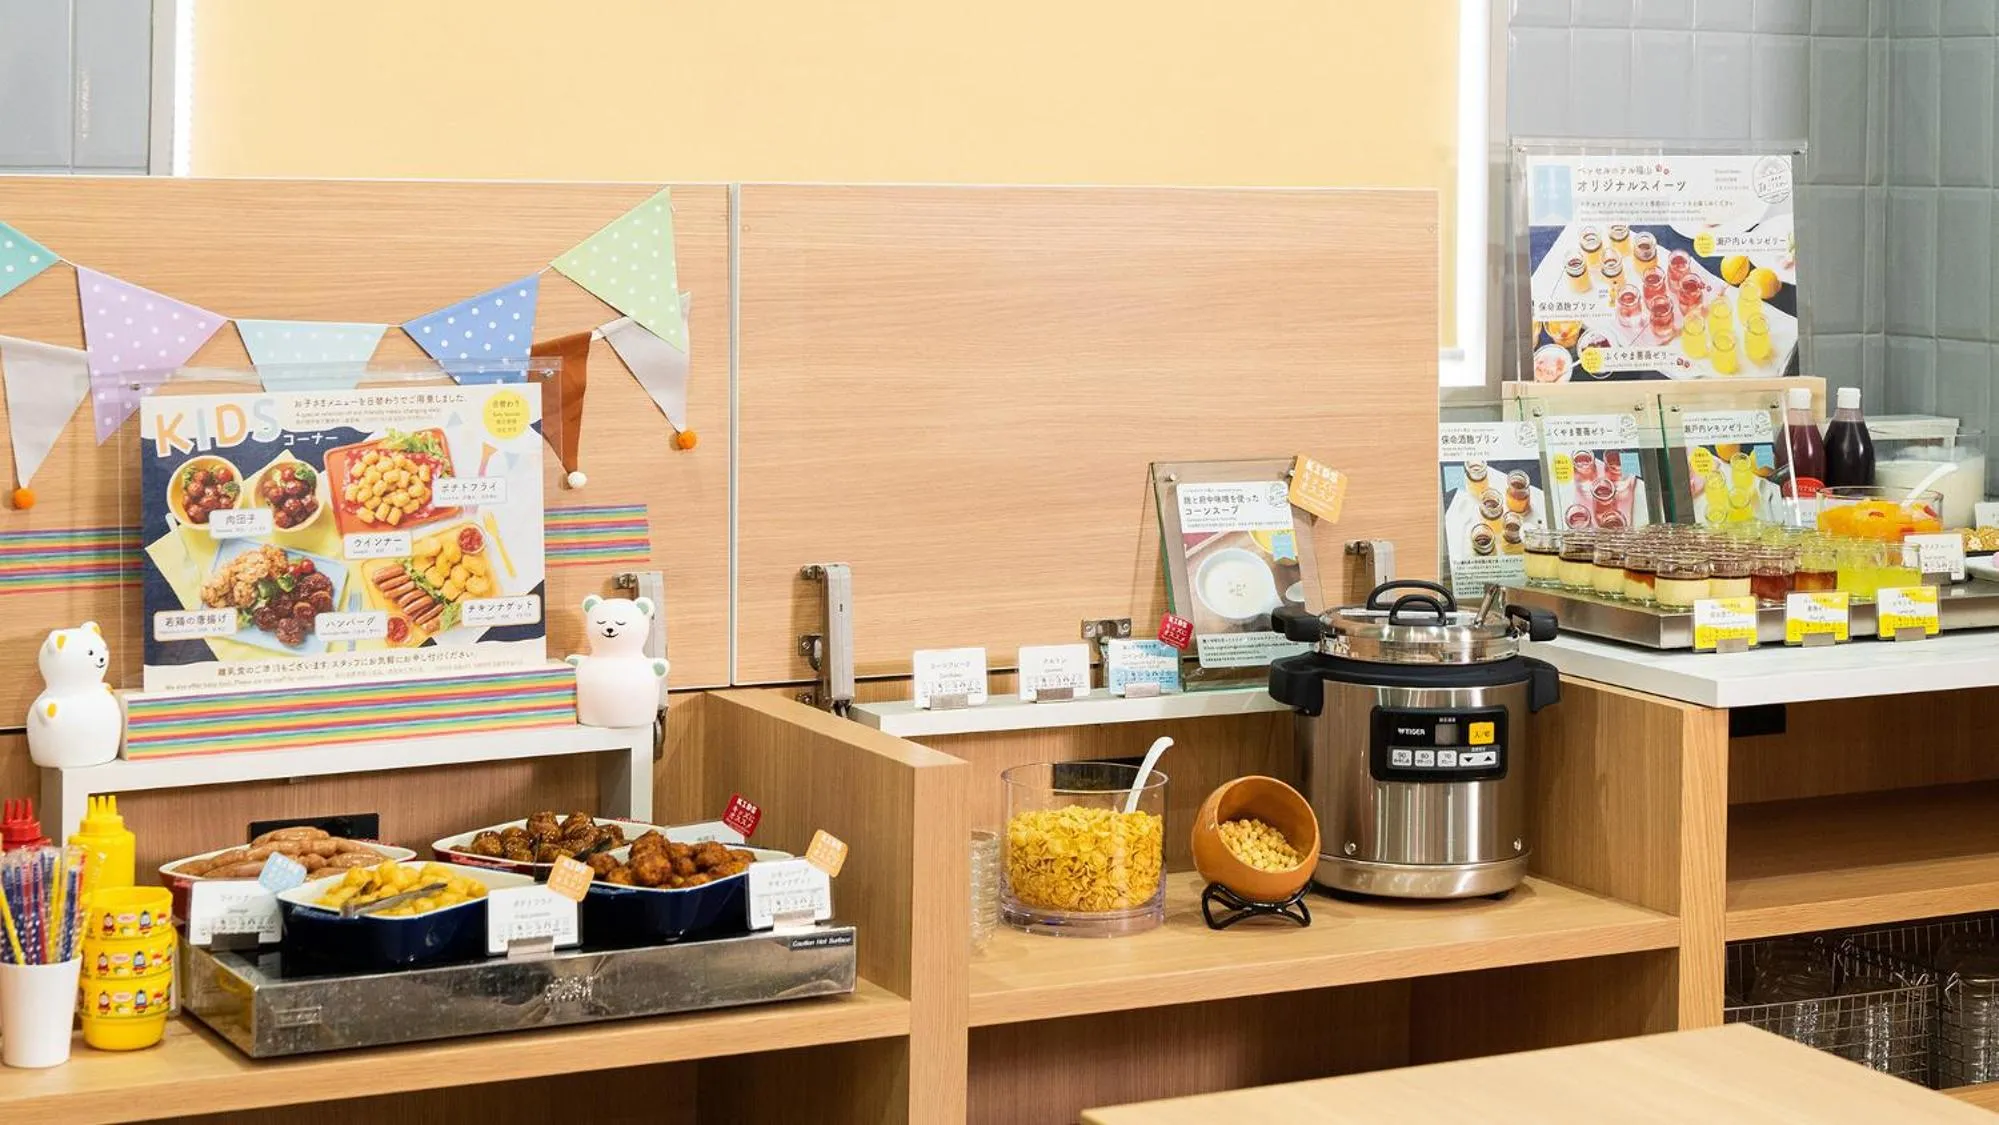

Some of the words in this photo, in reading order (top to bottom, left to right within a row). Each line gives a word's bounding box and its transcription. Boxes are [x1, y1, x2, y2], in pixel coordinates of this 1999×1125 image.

[1577, 180, 1686, 193] オリジナルスイーツ
[1716, 236, 1787, 246] 瀬戸内レモンゼリー
[1604, 350, 1680, 361] ふくやま薔薇ゼリー
[156, 399, 281, 458] KIDS
[283, 432, 339, 447] コーナー
[441, 482, 497, 493] ポテトフライ
[1185, 505, 1239, 516] コーンスープ
[225, 513, 255, 525] 肉団子
[353, 537, 402, 548] ウインナー
[468, 602, 533, 613] チキンナゲット
[164, 613, 227, 627] 若鶏の唐揚げ
[326, 616, 376, 628] ハンバーグ
[1405, 728, 1425, 736] TIGER
[736, 797, 758, 814] KIDS
